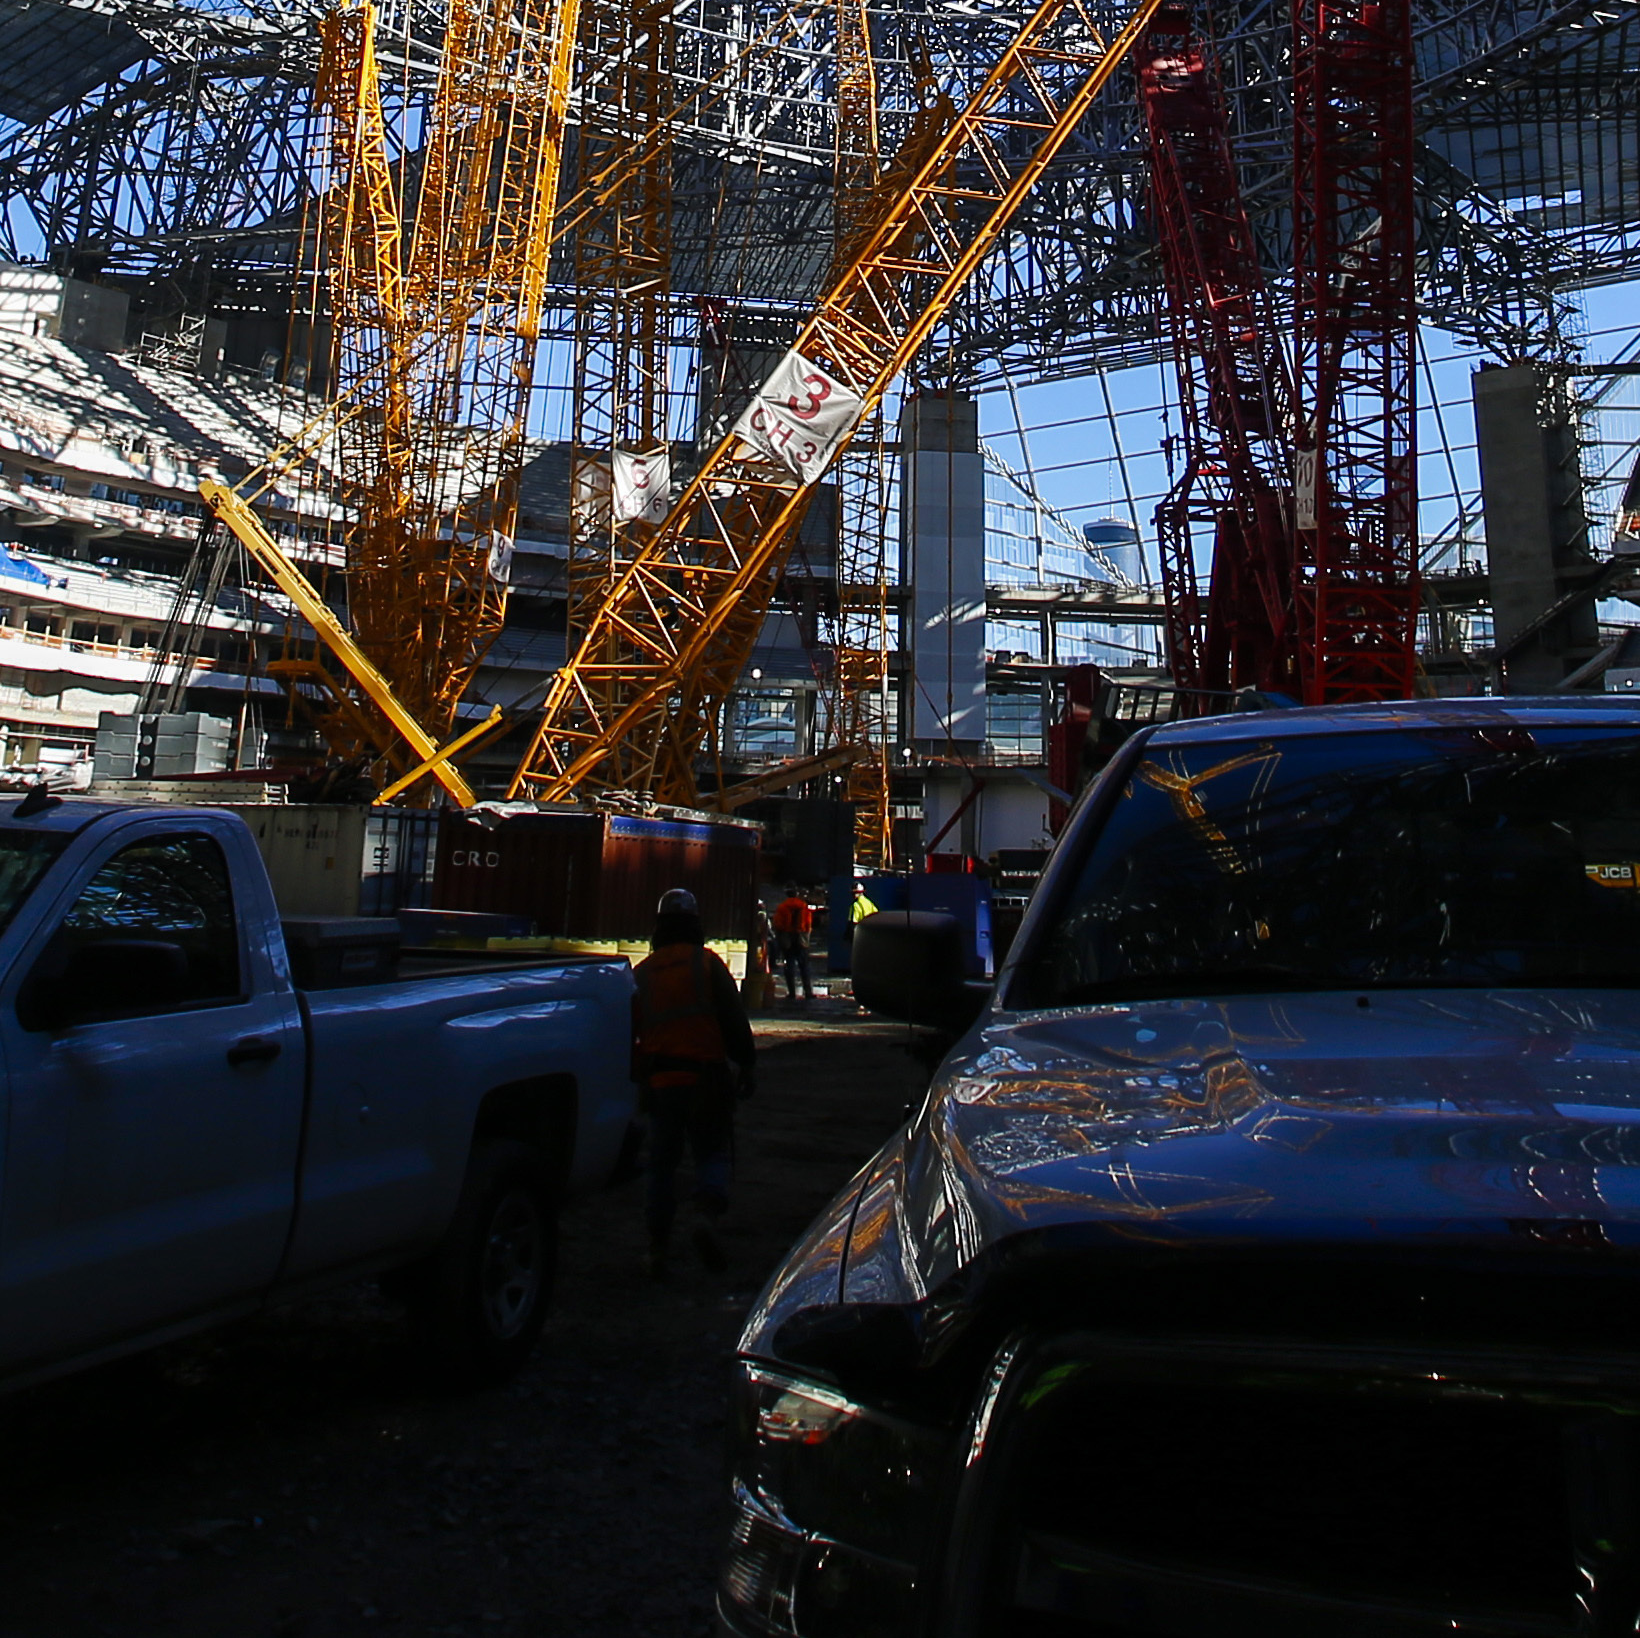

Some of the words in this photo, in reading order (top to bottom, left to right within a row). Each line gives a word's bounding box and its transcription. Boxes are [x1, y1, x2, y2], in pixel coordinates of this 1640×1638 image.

[788, 373, 832, 420] 3
[750, 408, 795, 448] CH
[796, 442, 817, 463] 3
[1600, 866, 1632, 879] JCB
